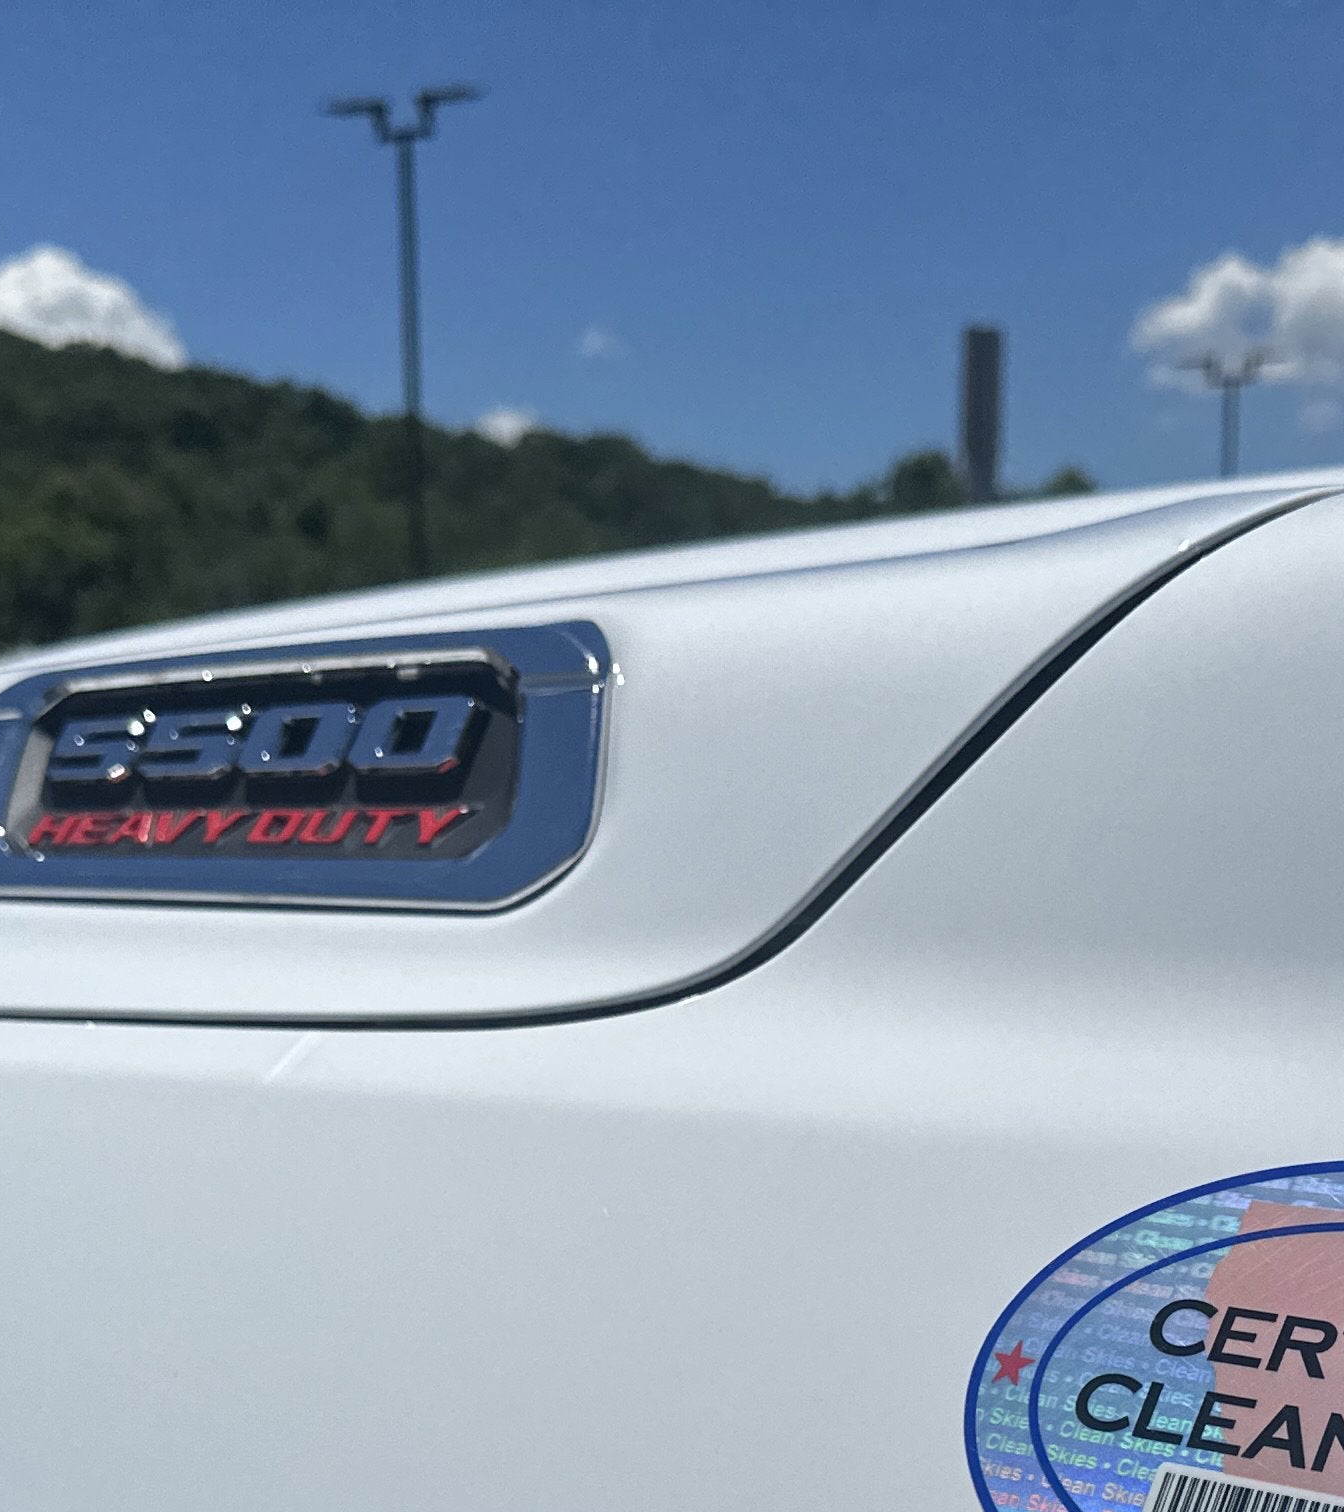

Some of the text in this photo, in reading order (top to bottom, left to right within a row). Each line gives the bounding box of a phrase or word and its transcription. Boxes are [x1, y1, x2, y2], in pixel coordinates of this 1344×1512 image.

[51, 694, 480, 786] 5500
[29, 806, 468, 847] HEAVY DUTY
